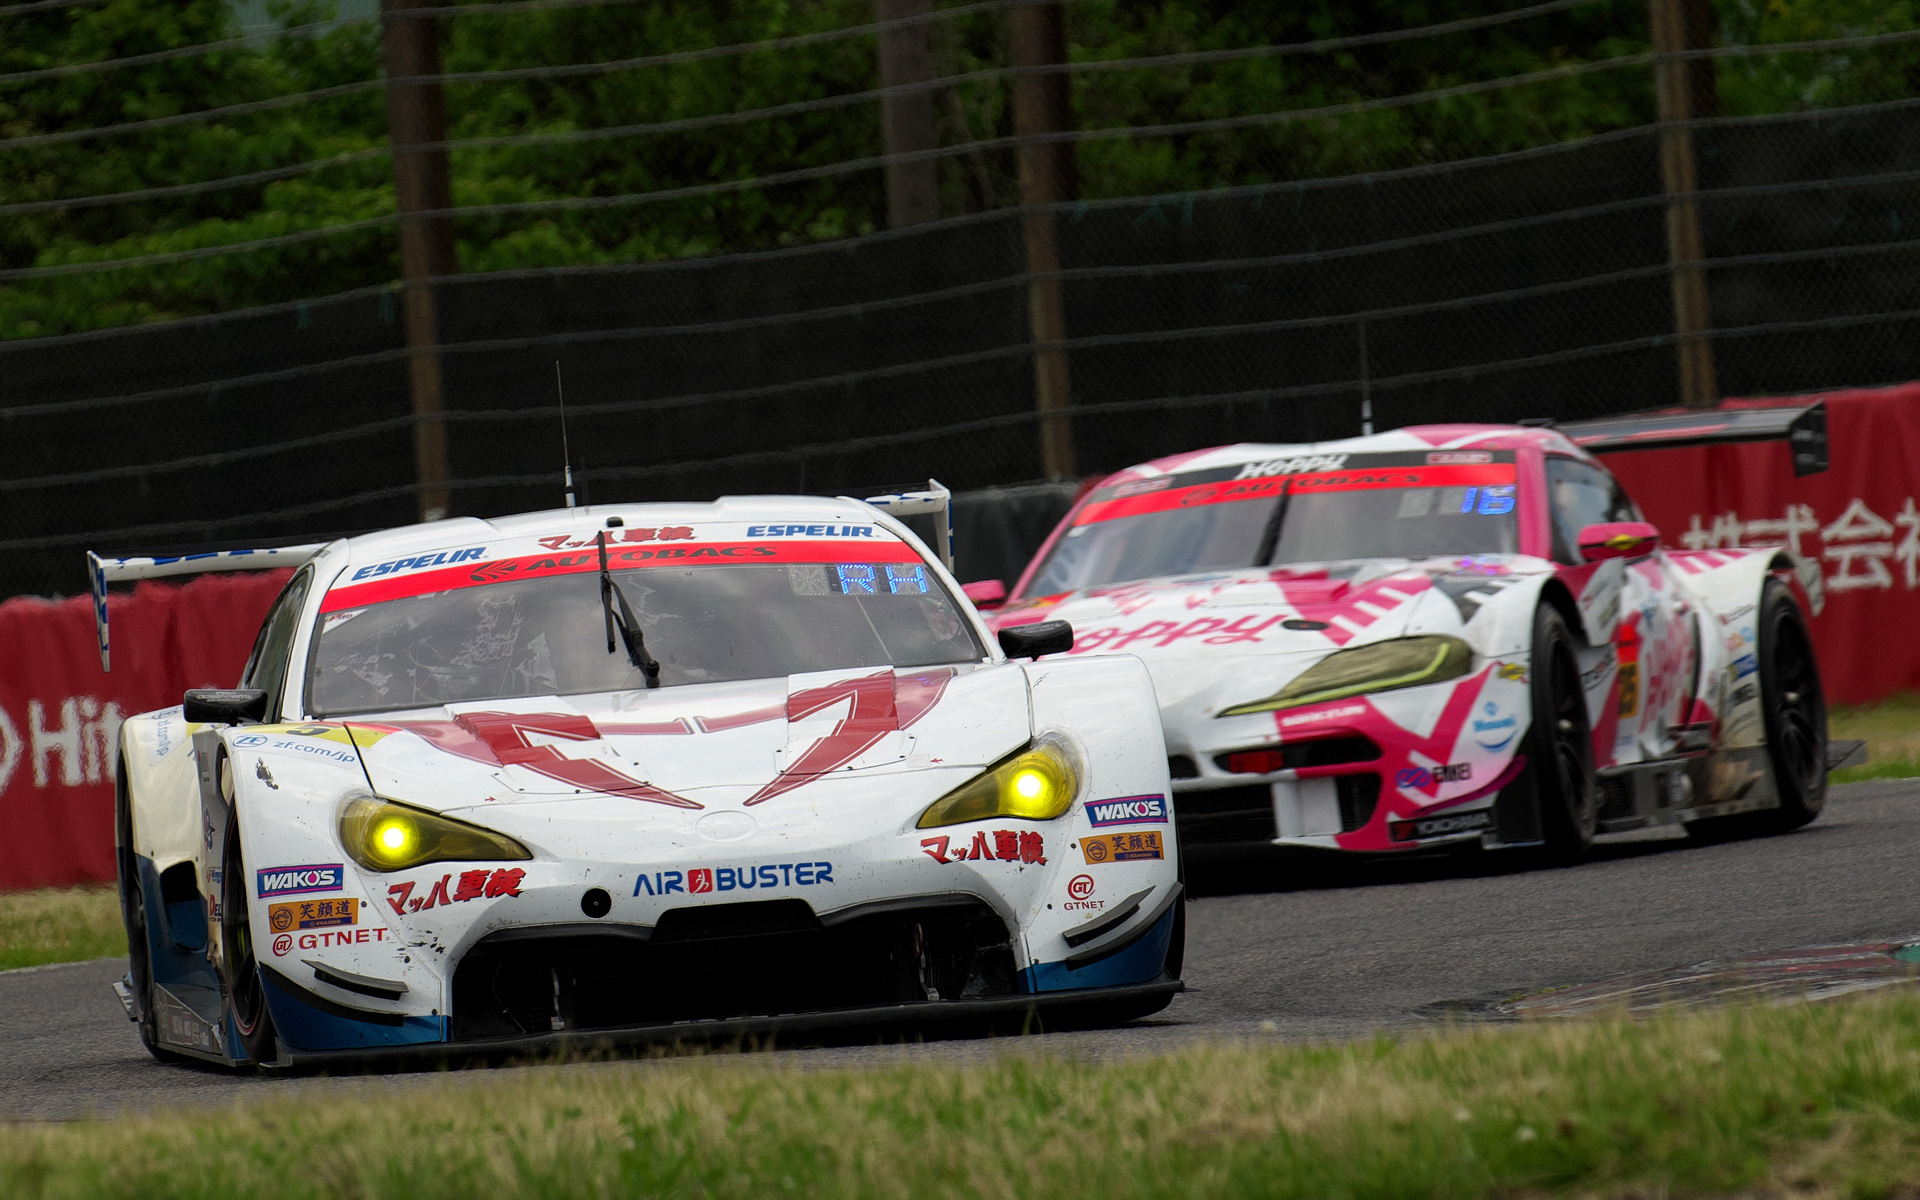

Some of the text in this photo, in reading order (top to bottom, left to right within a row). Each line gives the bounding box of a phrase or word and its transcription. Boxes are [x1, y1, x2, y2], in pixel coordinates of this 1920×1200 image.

[1222, 474, 1422, 496] AUOBACS
[537, 526, 698, 550] マッハ車検
[746, 525, 873, 538] ESPELIR
[351, 547, 487, 581] ESPELIR
[523, 547, 777, 571] AUTOBACS
[1068, 614, 1288, 655] oppy
[273, 741, 356, 762] zf.com/jp
[920, 830, 1048, 866] マッハ車検
[1112, 833, 1160, 851] 笑顔道
[632, 861, 834, 897] AIR BUSTER
[386, 867, 526, 916] マッハ車検
[300, 900, 352, 920] 笑顔道
[1064, 900, 1105, 911] GTNET
[298, 928, 388, 950] GTNET
